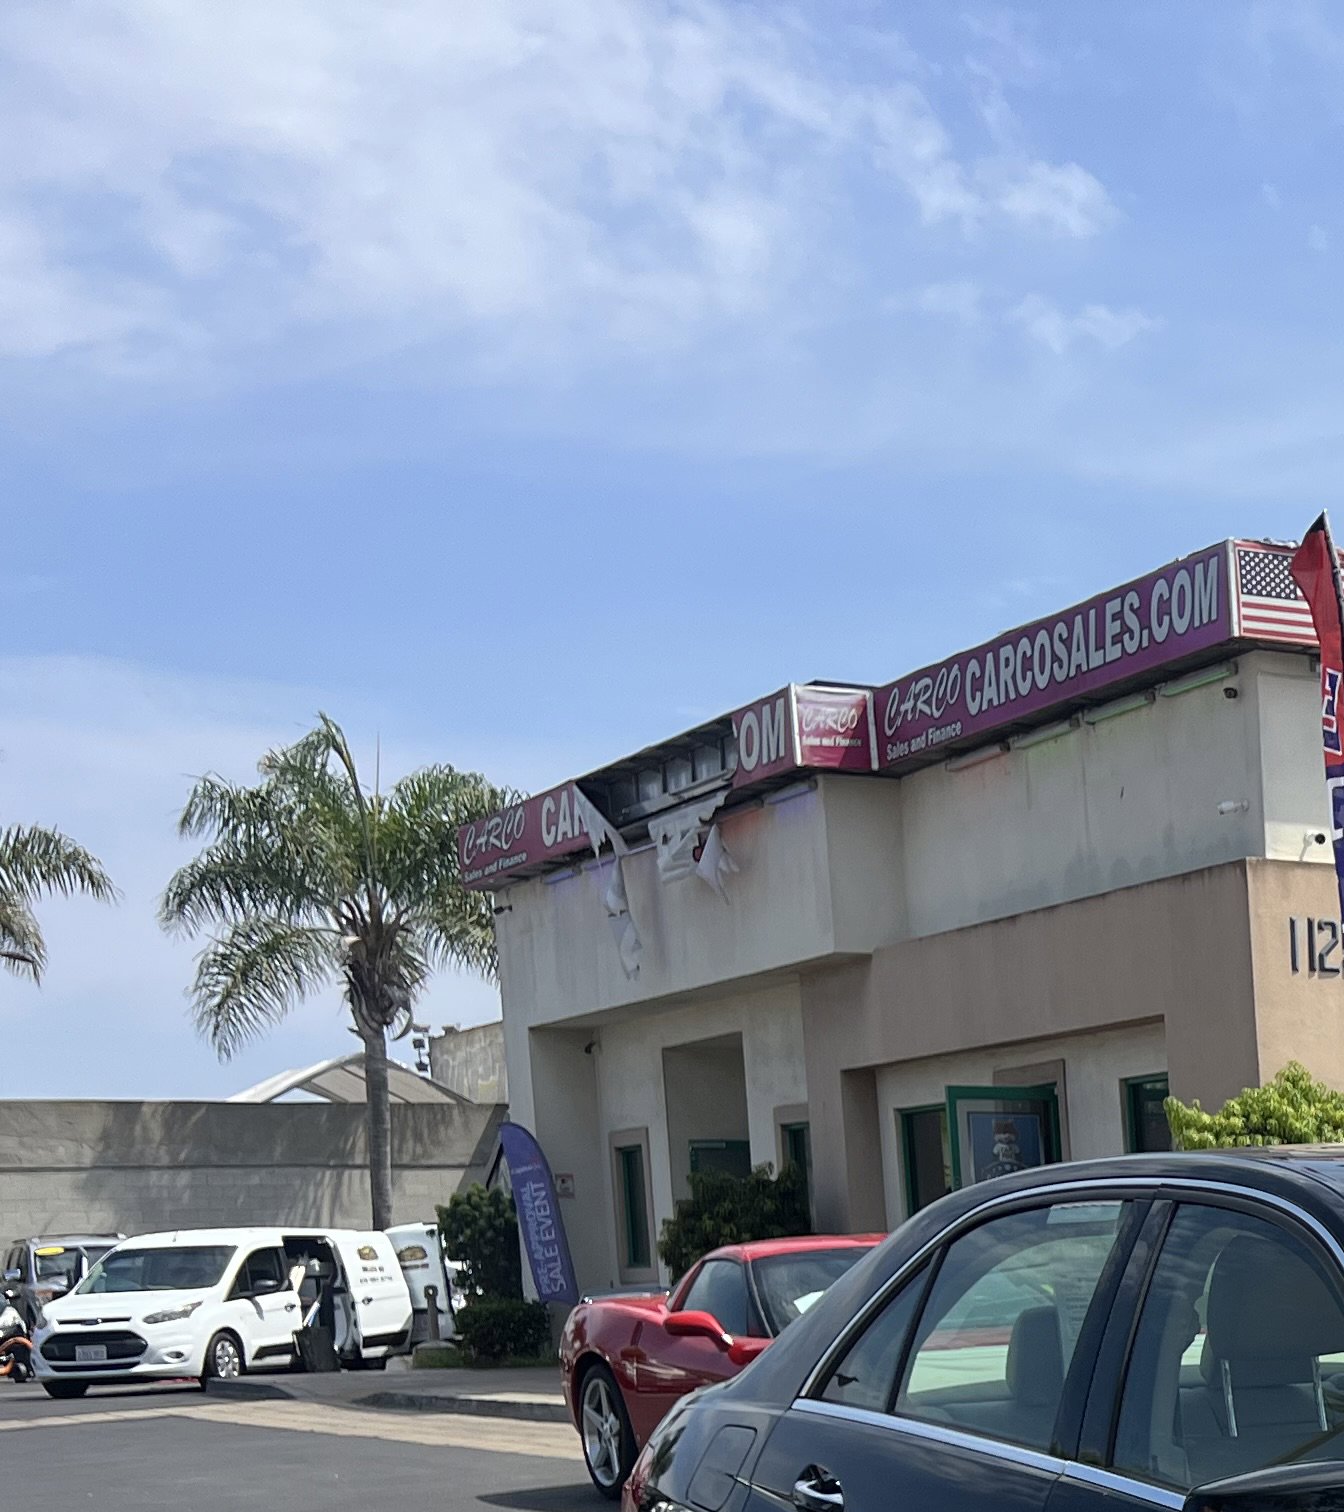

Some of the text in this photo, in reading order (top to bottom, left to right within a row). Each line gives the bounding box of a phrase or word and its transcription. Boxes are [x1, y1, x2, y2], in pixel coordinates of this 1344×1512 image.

[884, 664, 962, 737] CARCO
[965, 555, 1219, 717] CARCOSALES.COM
[802, 705, 859, 734] CARCO
[886, 720, 963, 762] Sales and Finance
[463, 805, 525, 866] CARCO
[732, 697, 786, 772] OM
[533, 1181, 567, 1293] SALE EVENT
